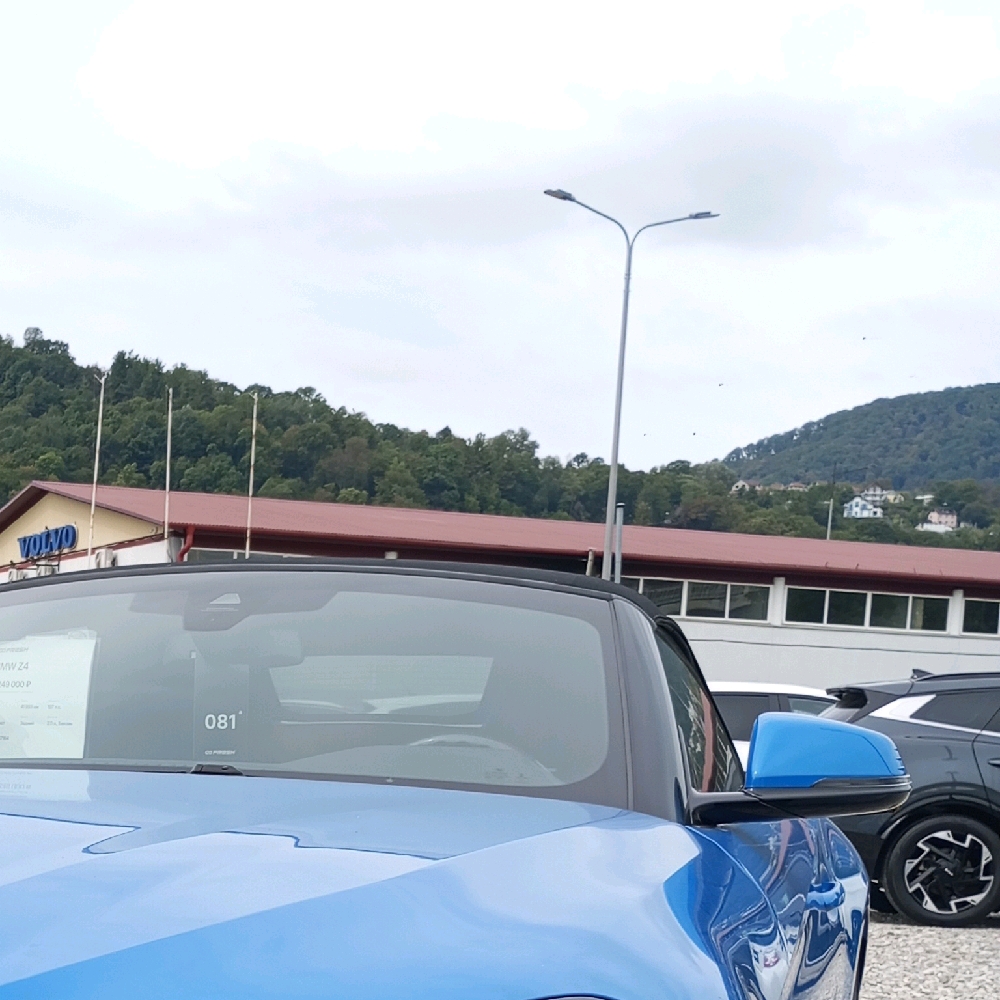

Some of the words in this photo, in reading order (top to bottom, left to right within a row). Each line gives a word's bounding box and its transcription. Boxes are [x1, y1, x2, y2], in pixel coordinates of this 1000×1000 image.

[17, 524, 77, 558] VOLVO
[18, 661, 29, 671] Z4
[11, 680, 25, 688] 000
[204, 713, 236, 730] 081
